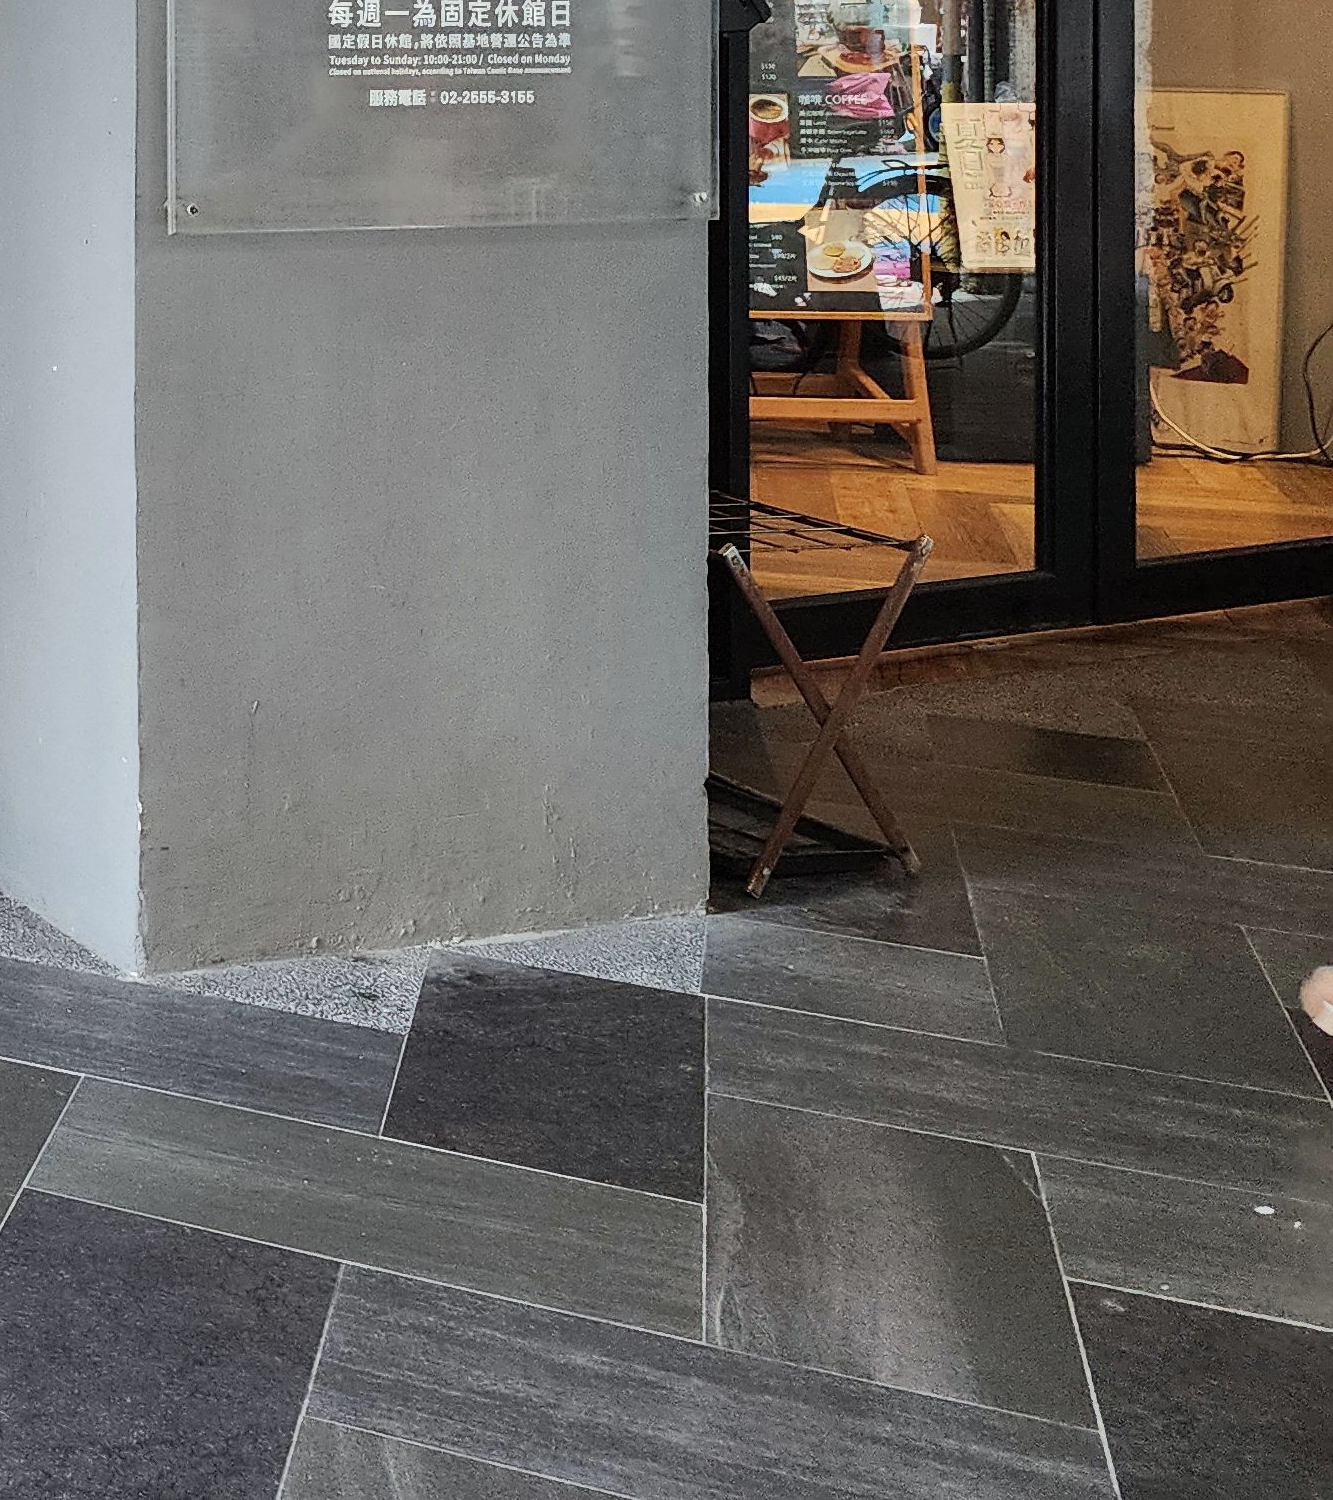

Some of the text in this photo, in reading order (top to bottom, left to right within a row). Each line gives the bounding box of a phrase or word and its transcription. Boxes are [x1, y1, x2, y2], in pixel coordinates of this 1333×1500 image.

[328, 54, 370, 67] Tuesday
[371, 54, 381, 65] to
[383, 54, 421, 67] Sunday:
[423, 54, 478, 65] 10:00-21:00
[487, 54, 519, 65] Closed
[520, 55, 533, 65] on
[534, 54, 571, 66] Monday
[824, 94, 870, 105] COFFEE
